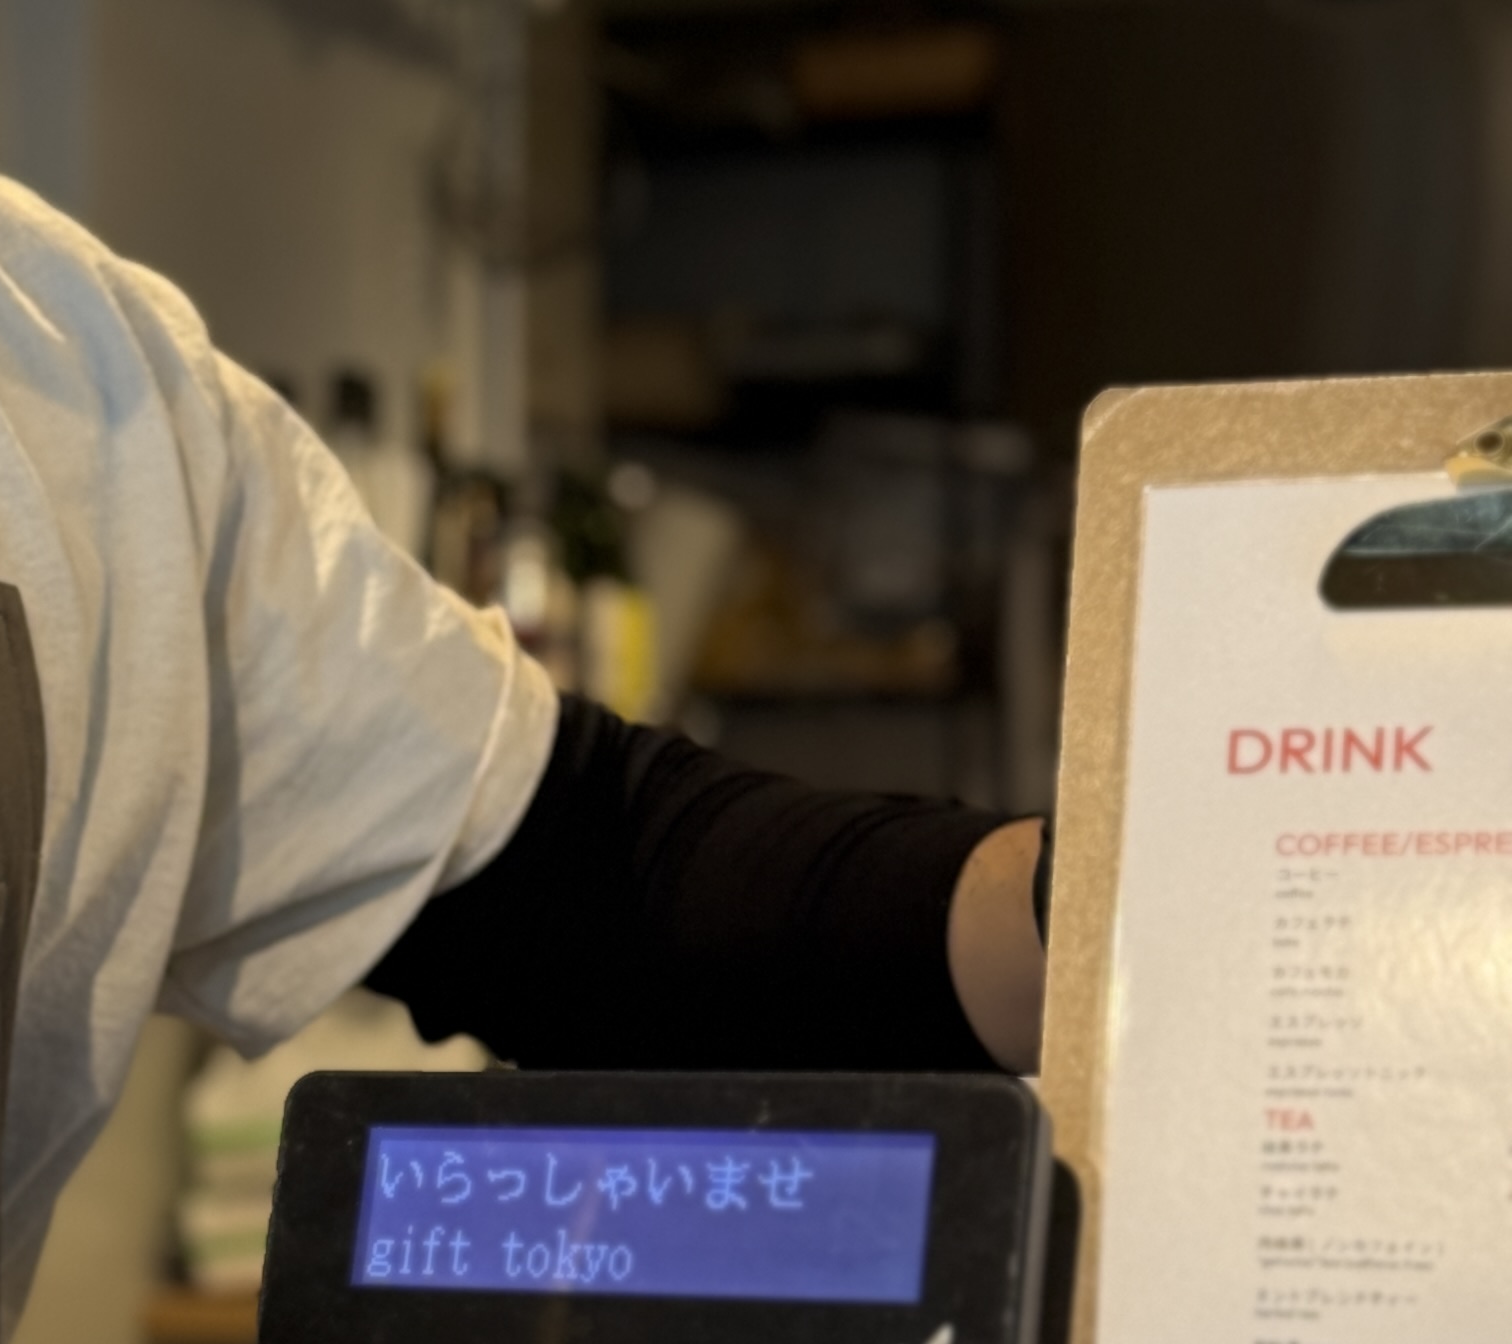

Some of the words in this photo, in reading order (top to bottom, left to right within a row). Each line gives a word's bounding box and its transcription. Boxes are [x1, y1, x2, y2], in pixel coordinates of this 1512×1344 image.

[1227, 725, 1434, 776] DRINK
[1275, 830, 1512, 858] COFFEE/ESPRE
[1262, 1108, 1316, 1132] TEA
[379, 1150, 815, 1212] いらっしゃいませ
[365, 1225, 472, 1279] gift
[501, 1228, 634, 1283] tokyo
